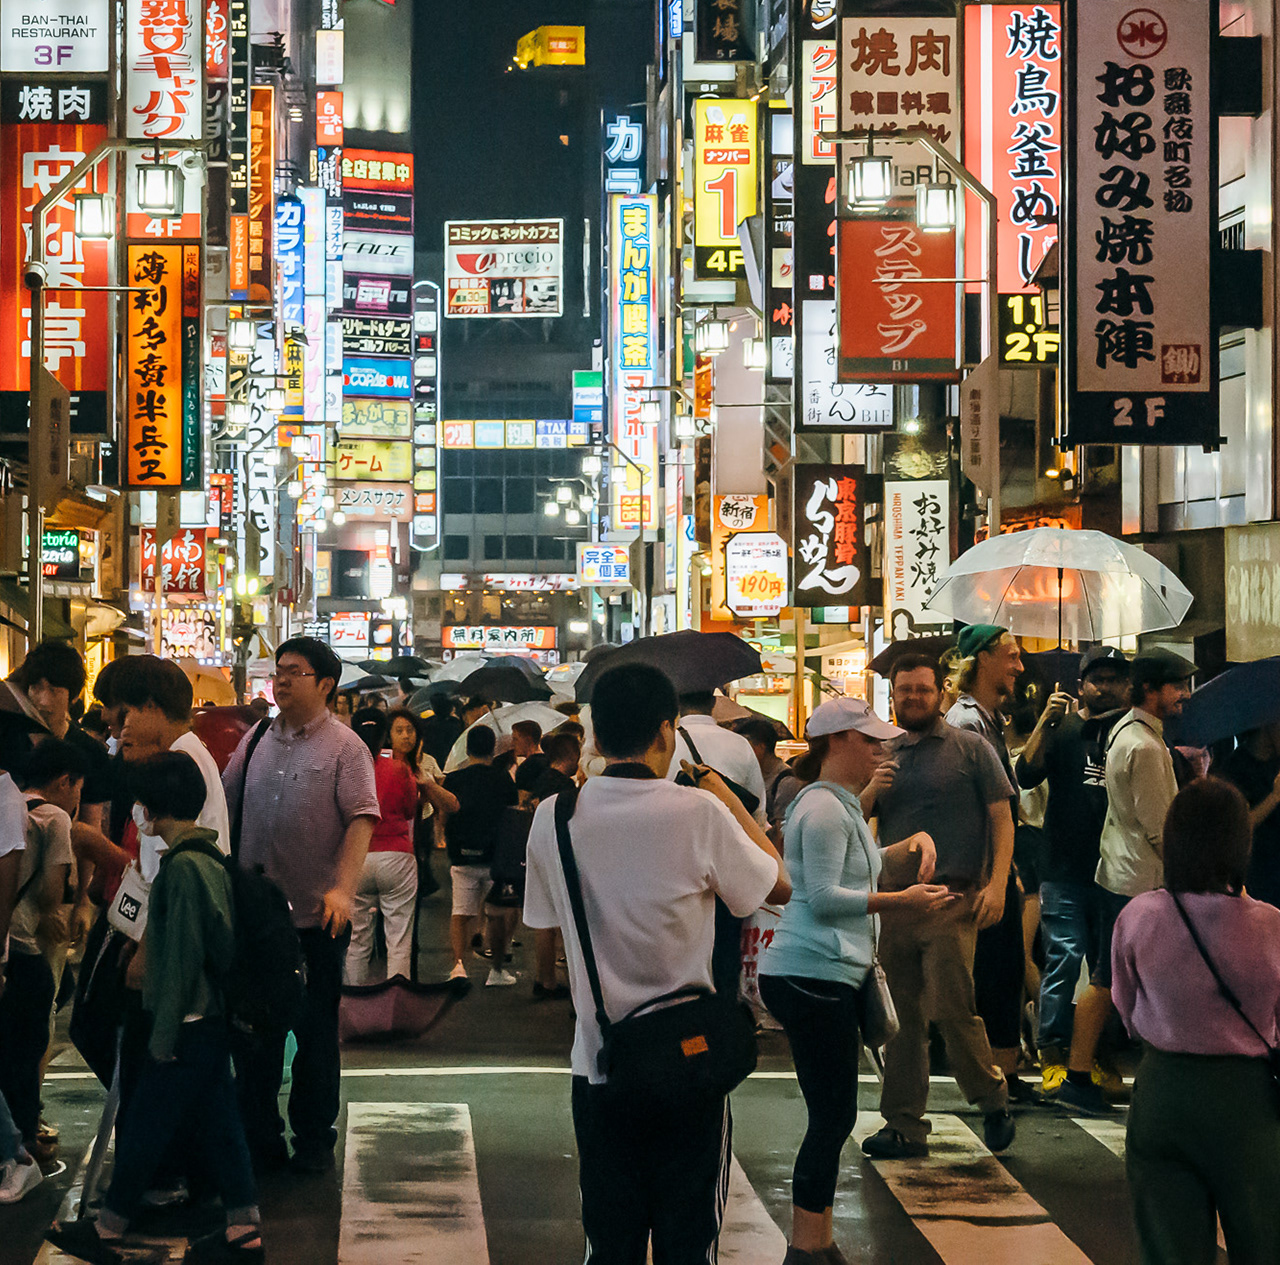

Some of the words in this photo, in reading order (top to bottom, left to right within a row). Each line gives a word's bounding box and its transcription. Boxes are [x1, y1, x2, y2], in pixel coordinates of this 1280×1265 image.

[20, 14, 89, 26] BAN-THAI
[11, 26, 98, 39] RESTAURANT
[33, 44, 75, 67] 3F
[18, 85, 91, 121] 焼肉
[704, 123, 750, 144] 麻雀
[704, 150, 749, 163] ナンバー
[1006, 7, 1061, 290] 焼鳥釜めし
[342, 157, 411, 183] 全店営業中
[704, 168, 738, 239] 1
[1093, 61, 1157, 370] お好み焼本陣
[145, 218, 183, 236] 4F
[331, 207, 343, 254] カラオケ
[450, 225, 559, 242] コミック&ネットカフェ
[276, 201, 302, 303] カラオケ
[706, 249, 746, 273] 4F
[620, 204, 652, 370] まんが喫茶
[873, 225, 927, 355] ステップ
[1004, 332, 1060, 363] 2F
[891, 359, 910, 372] B1
[1113, 397, 1167, 428] 2F
[546, 421, 568, 435] TAX
[339, 452, 384, 473] ゲーム
[721, 501, 755, 519] 新宿
[833, 475, 858, 565] 東京豚骨
[891, 492, 903, 540] HIROSHIMA
[732, 518, 745, 529] の
[585, 550, 615, 565] 完全
[598, 564, 628, 579] 個室
[739, 574, 782, 594] 190円
[451, 627, 536, 643] 無料案内所
